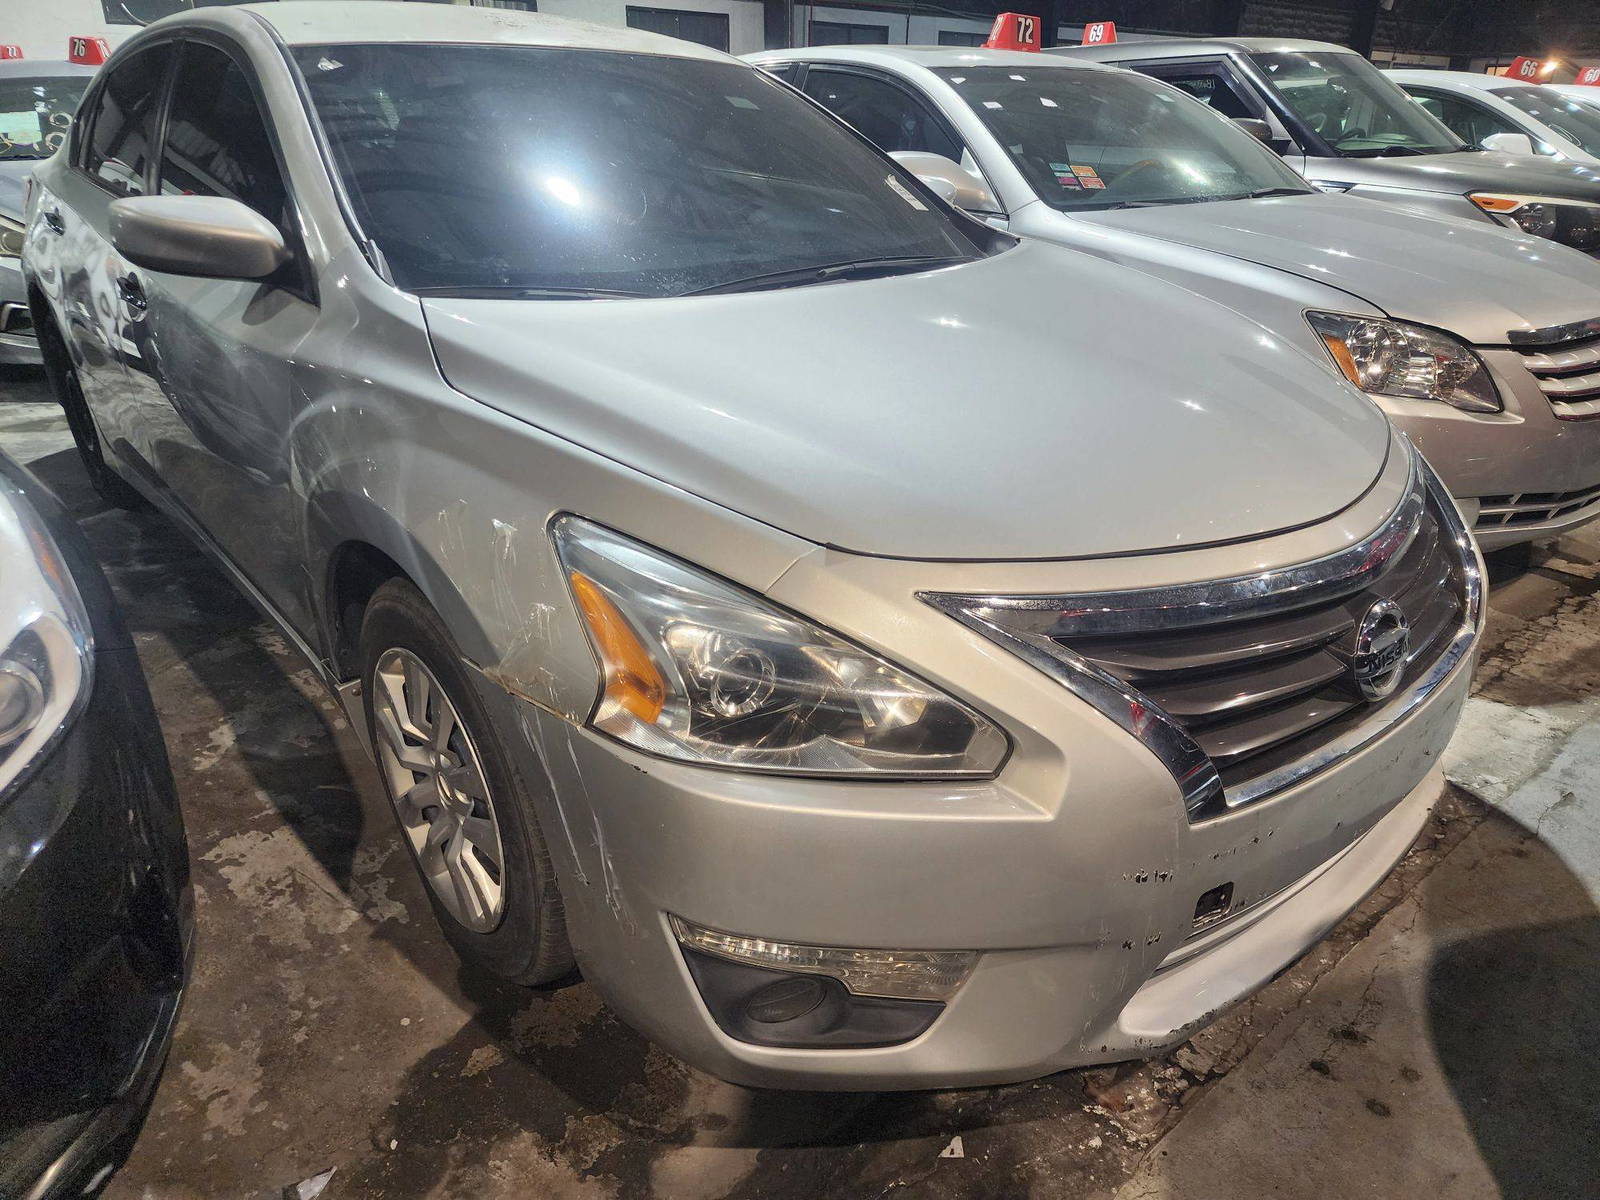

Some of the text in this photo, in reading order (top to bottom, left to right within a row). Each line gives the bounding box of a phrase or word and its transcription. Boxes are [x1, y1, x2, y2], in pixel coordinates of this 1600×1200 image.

[1017, 17, 1033, 44] 72
[1089, 24, 1104, 42] 69
[73, 39, 86, 57] 76
[1521, 60, 1538, 78] 66
